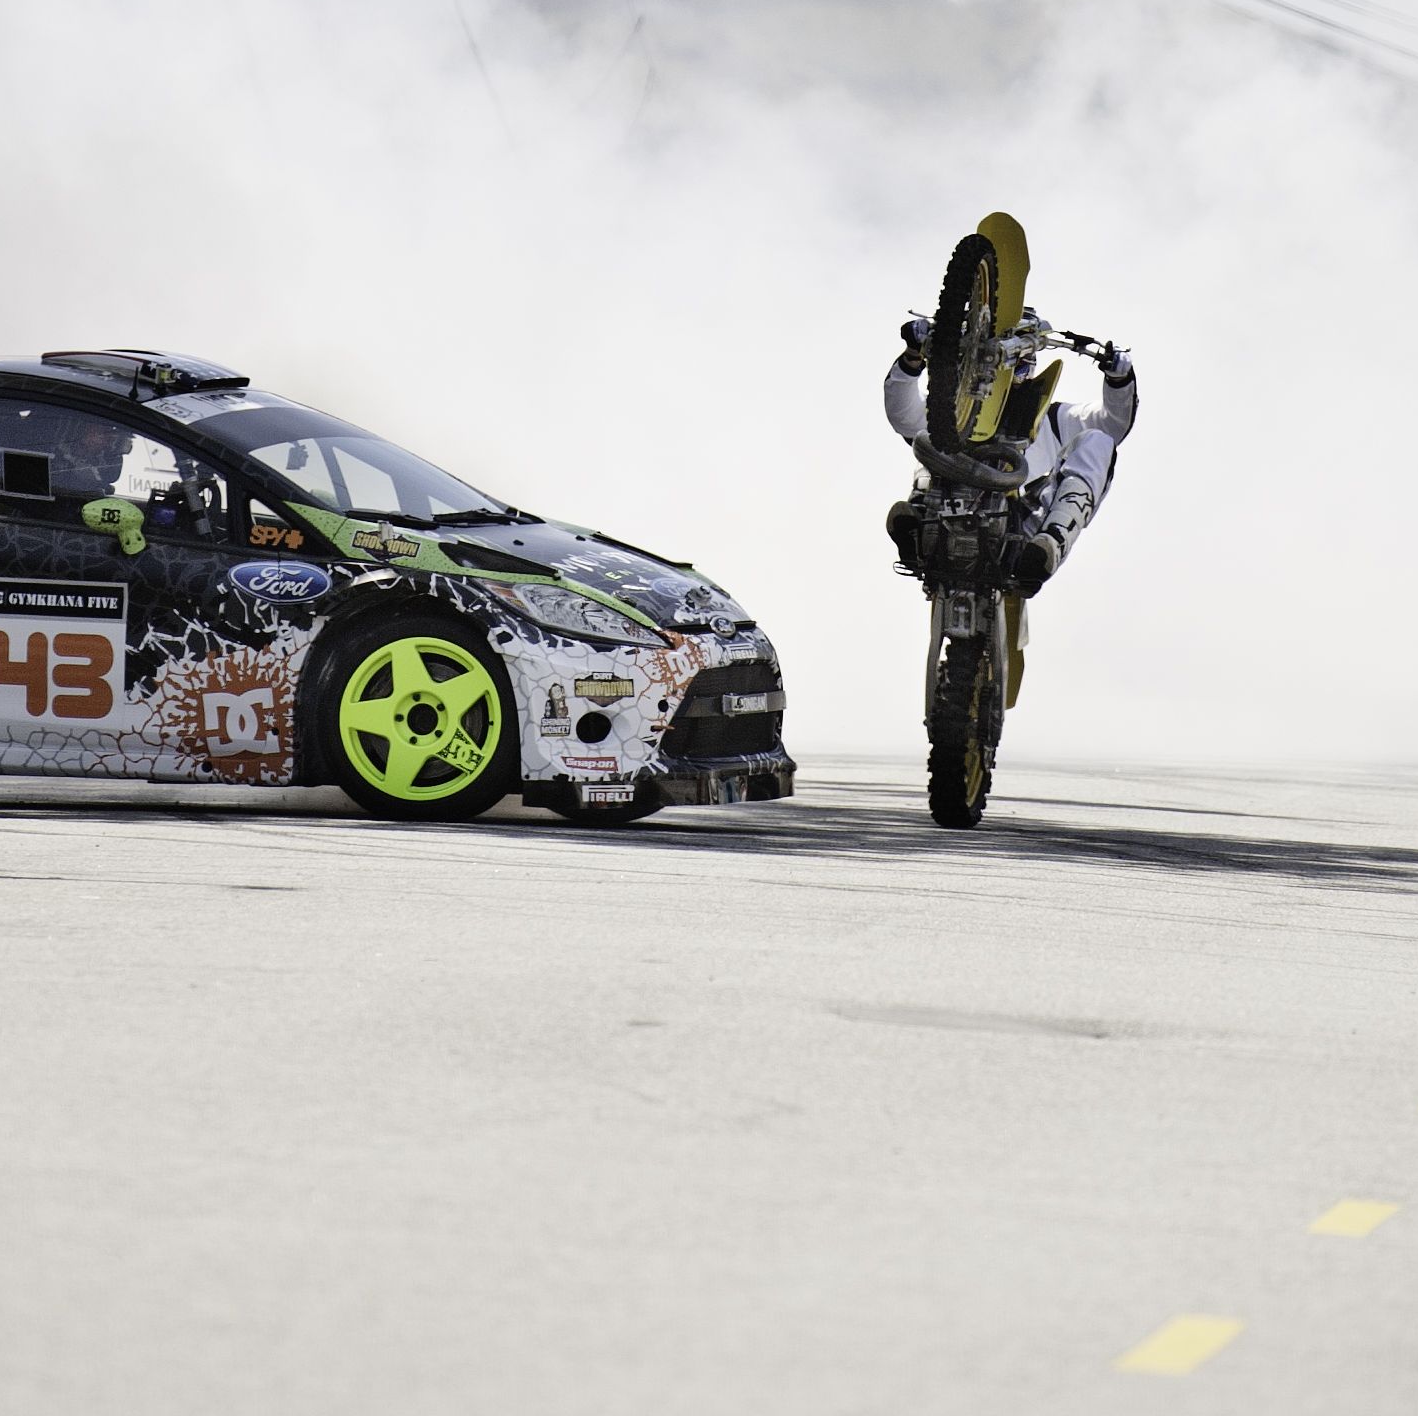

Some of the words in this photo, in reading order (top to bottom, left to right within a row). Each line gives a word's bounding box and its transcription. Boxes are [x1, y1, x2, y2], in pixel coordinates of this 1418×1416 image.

[249, 567, 314, 596] Ford
[8, 592, 82, 608] GYMKHANA
[87, 596, 118, 610] FIVE
[575, 680, 633, 697] SHOWDOWN
[565, 757, 615, 770] Snap-on
[582, 784, 635, 802] PIRELLI
